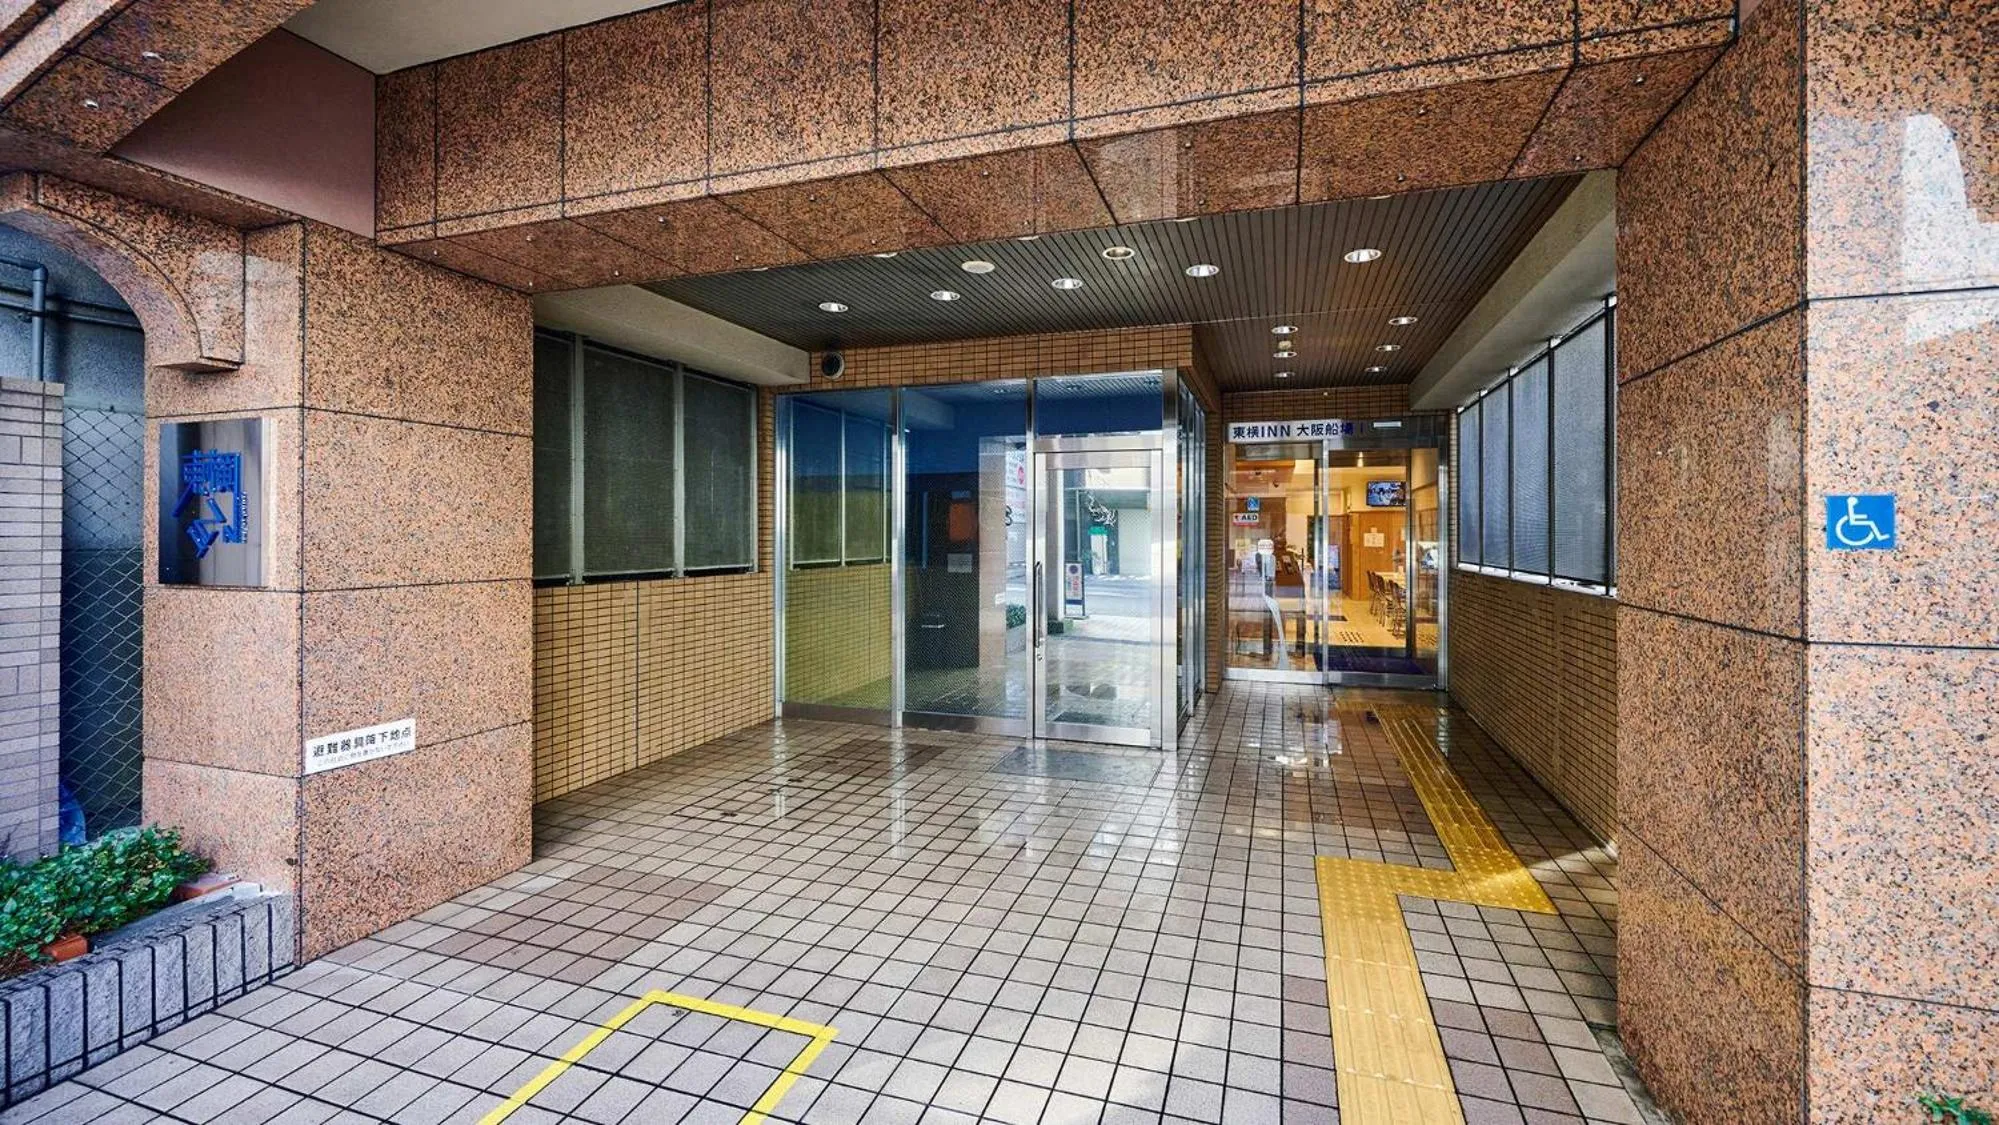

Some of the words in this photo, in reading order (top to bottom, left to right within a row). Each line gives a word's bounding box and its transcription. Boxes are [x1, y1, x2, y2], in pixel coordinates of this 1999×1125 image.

[1233, 424, 1292, 439] 東横INN
[1296, 422, 1354, 437] 大阪船場
